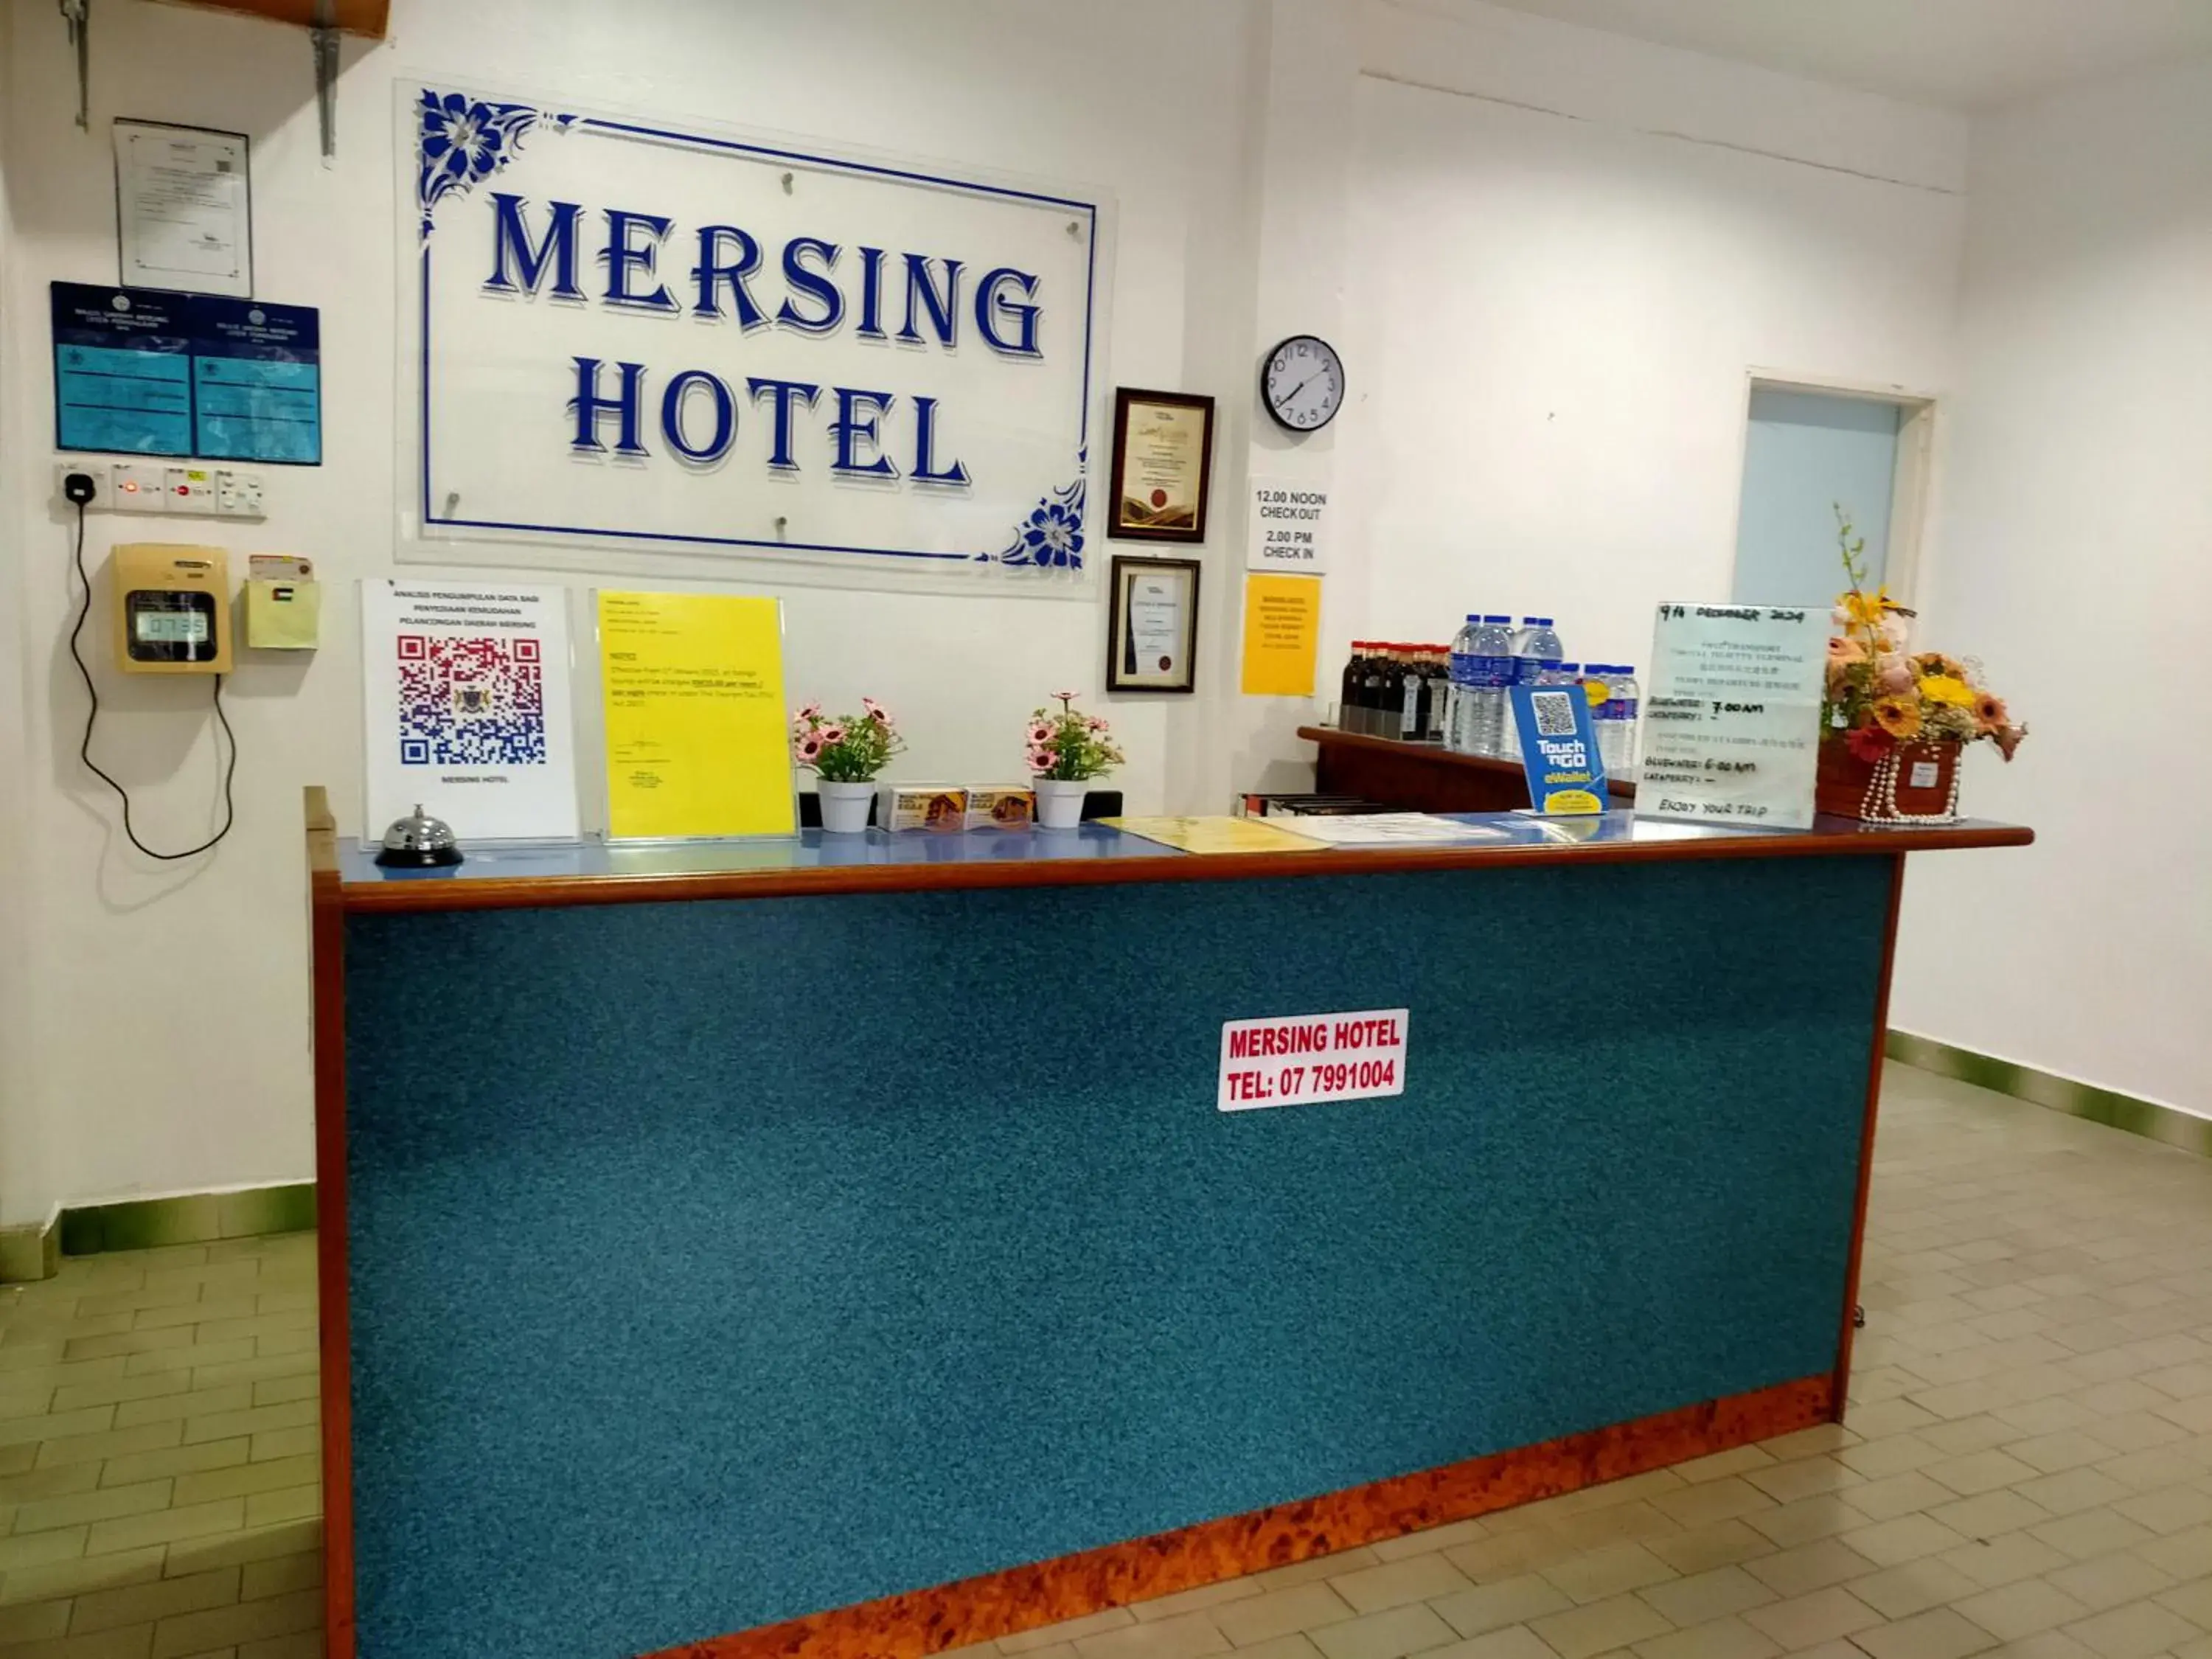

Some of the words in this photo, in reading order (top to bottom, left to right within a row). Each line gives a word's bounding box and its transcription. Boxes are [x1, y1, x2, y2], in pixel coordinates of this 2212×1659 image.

[481, 191, 1046, 360] MERSING
[566, 355, 973, 487] HOTEL
[1285, 408, 1294, 420] 7
[1297, 413, 1306, 425] 6
[1310, 408, 1318, 422] 5
[1256, 490, 1287, 503] 12.00
[1290, 492, 1326, 505] NOON
[1266, 530, 1290, 543] 2.00
[1294, 532, 1312, 543] PM
[1263, 546, 1301, 559] CHECK
[1536, 739, 1585, 754] Touch
[1659, 799, 1696, 813] ENJOY
[1702, 802, 1731, 815] YOUR
[1736, 804, 1767, 817] TRIP
[1229, 1023, 1327, 1059] MERSING
[1334, 1019, 1400, 1050] HOTEL
[1227, 1071, 1274, 1101] TEL:
[1280, 1067, 1306, 1096] 07
[1312, 1059, 1395, 1093] 7991004
